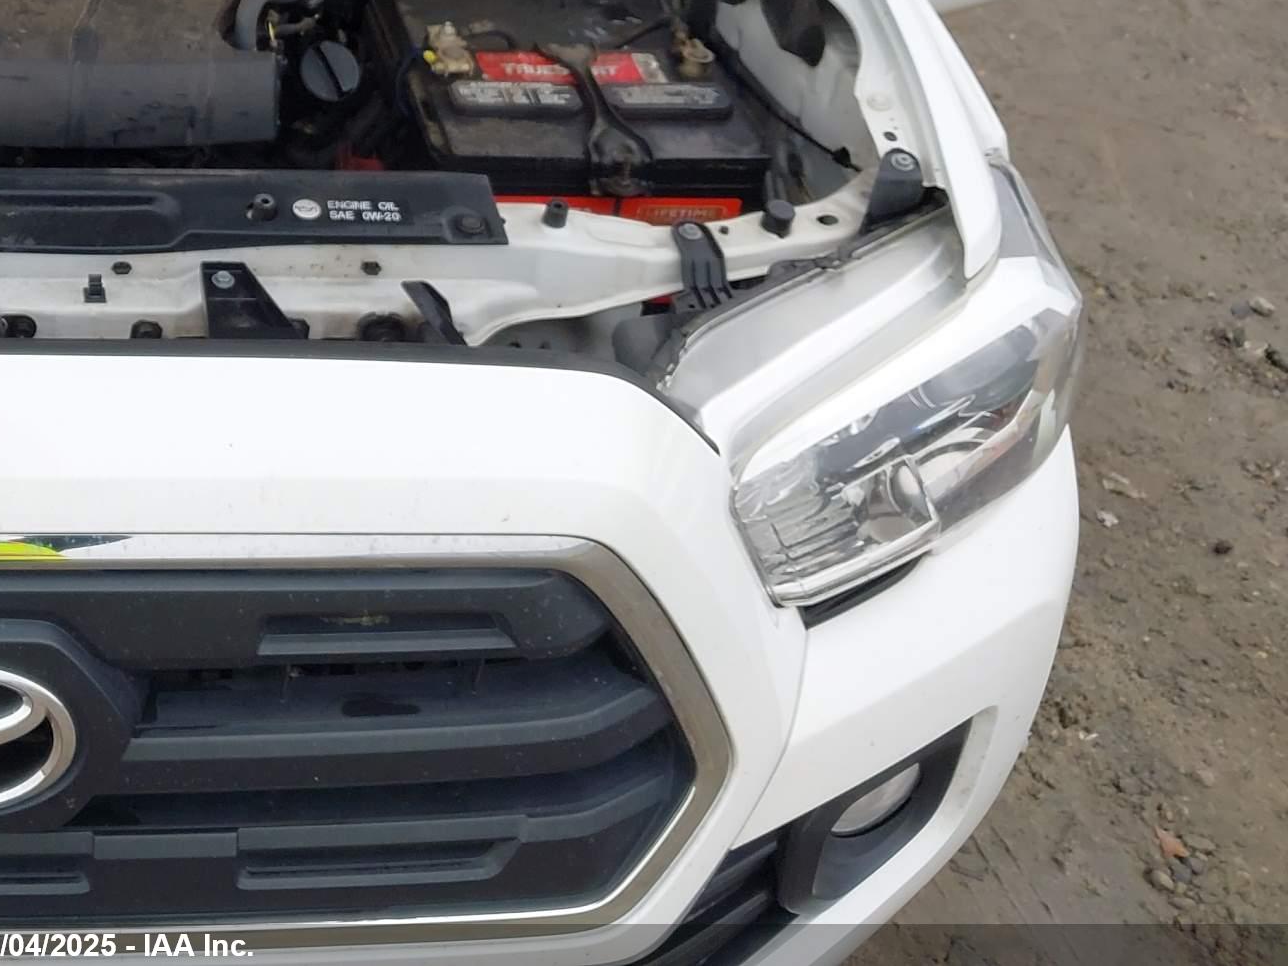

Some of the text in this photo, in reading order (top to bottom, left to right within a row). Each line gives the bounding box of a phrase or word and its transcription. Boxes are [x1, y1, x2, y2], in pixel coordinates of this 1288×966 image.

[327, 200, 400, 212] ENGINE OIL
[329, 210, 402, 222] SAE 0W-20
